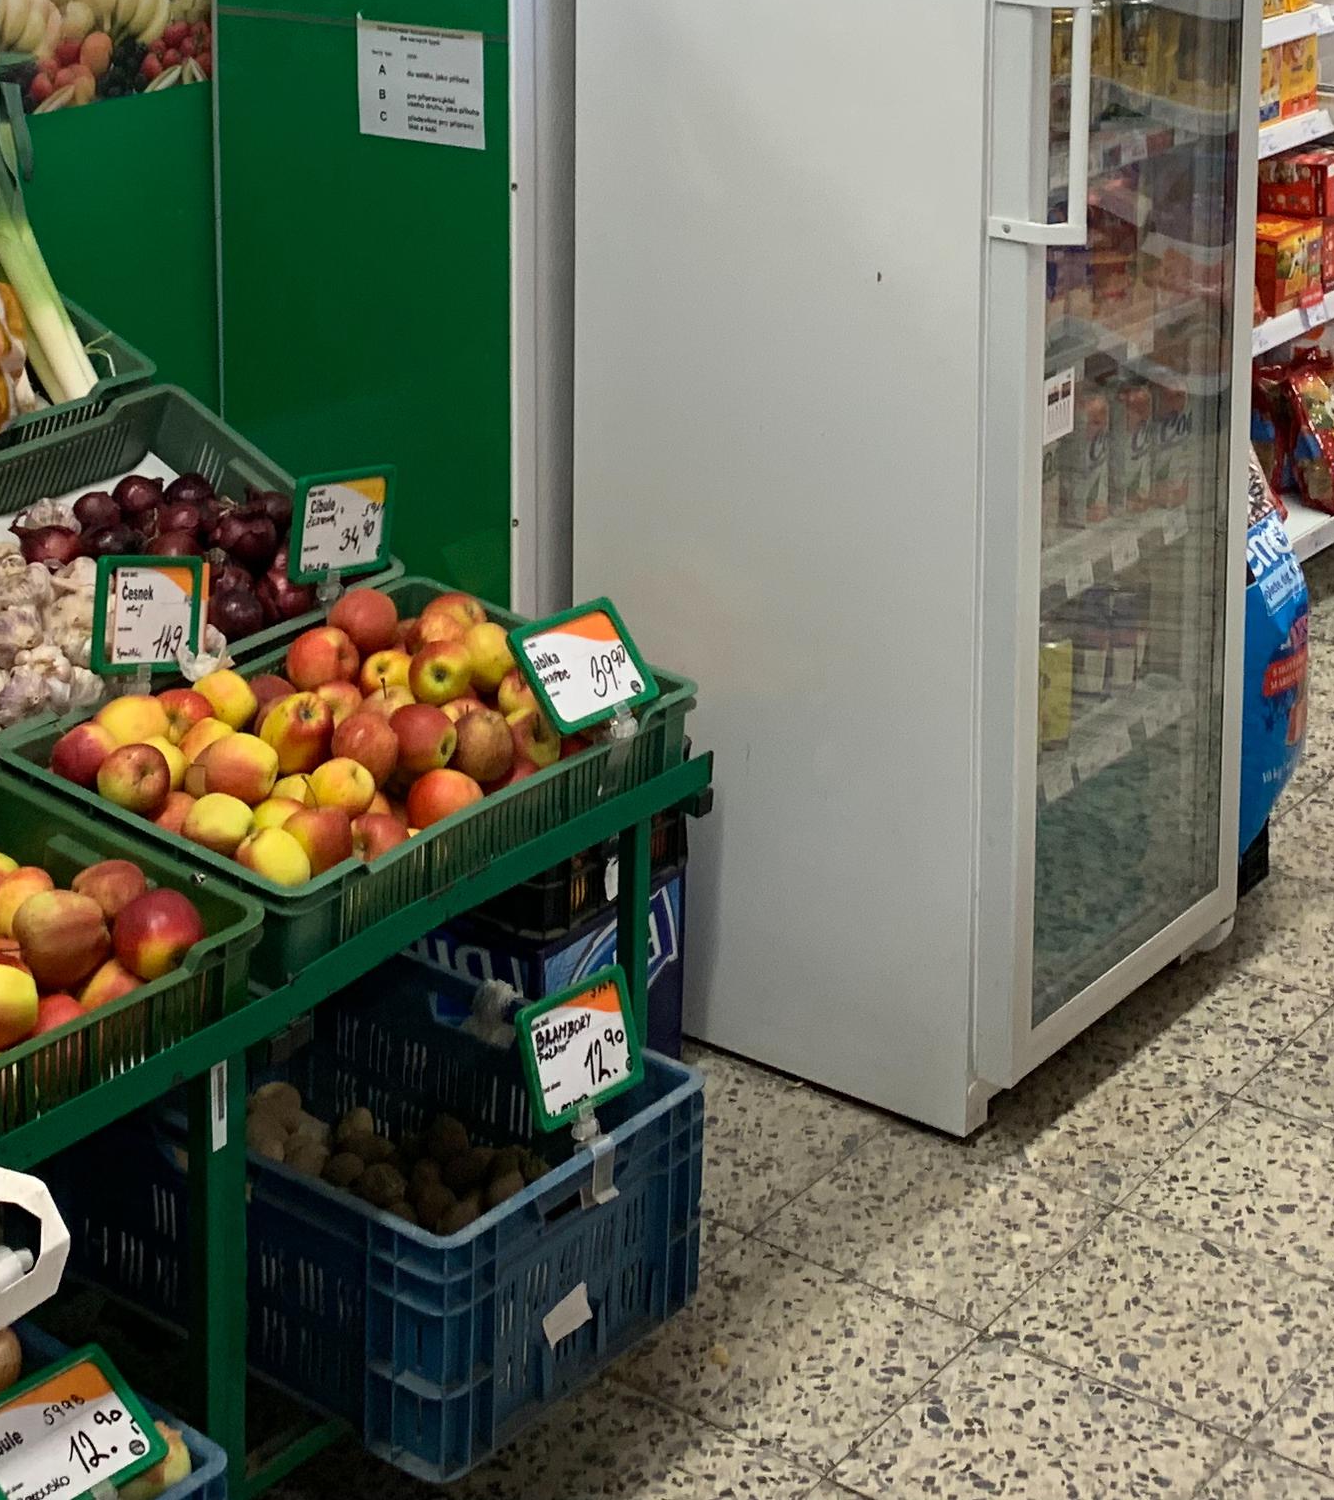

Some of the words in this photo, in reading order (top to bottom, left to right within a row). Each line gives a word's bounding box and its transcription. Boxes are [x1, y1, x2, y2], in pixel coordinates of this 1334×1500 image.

[378, 64, 386, 76] A
[378, 88, 386, 100] B
[379, 111, 387, 122] C
[122, 581, 154, 601] Česnek
[533, 651, 560, 672] ablka
[535, 1013, 591, 1051] BRAMBORY
[603, 1028, 624, 1044] 90
[93, 1409, 123, 1426] 90
